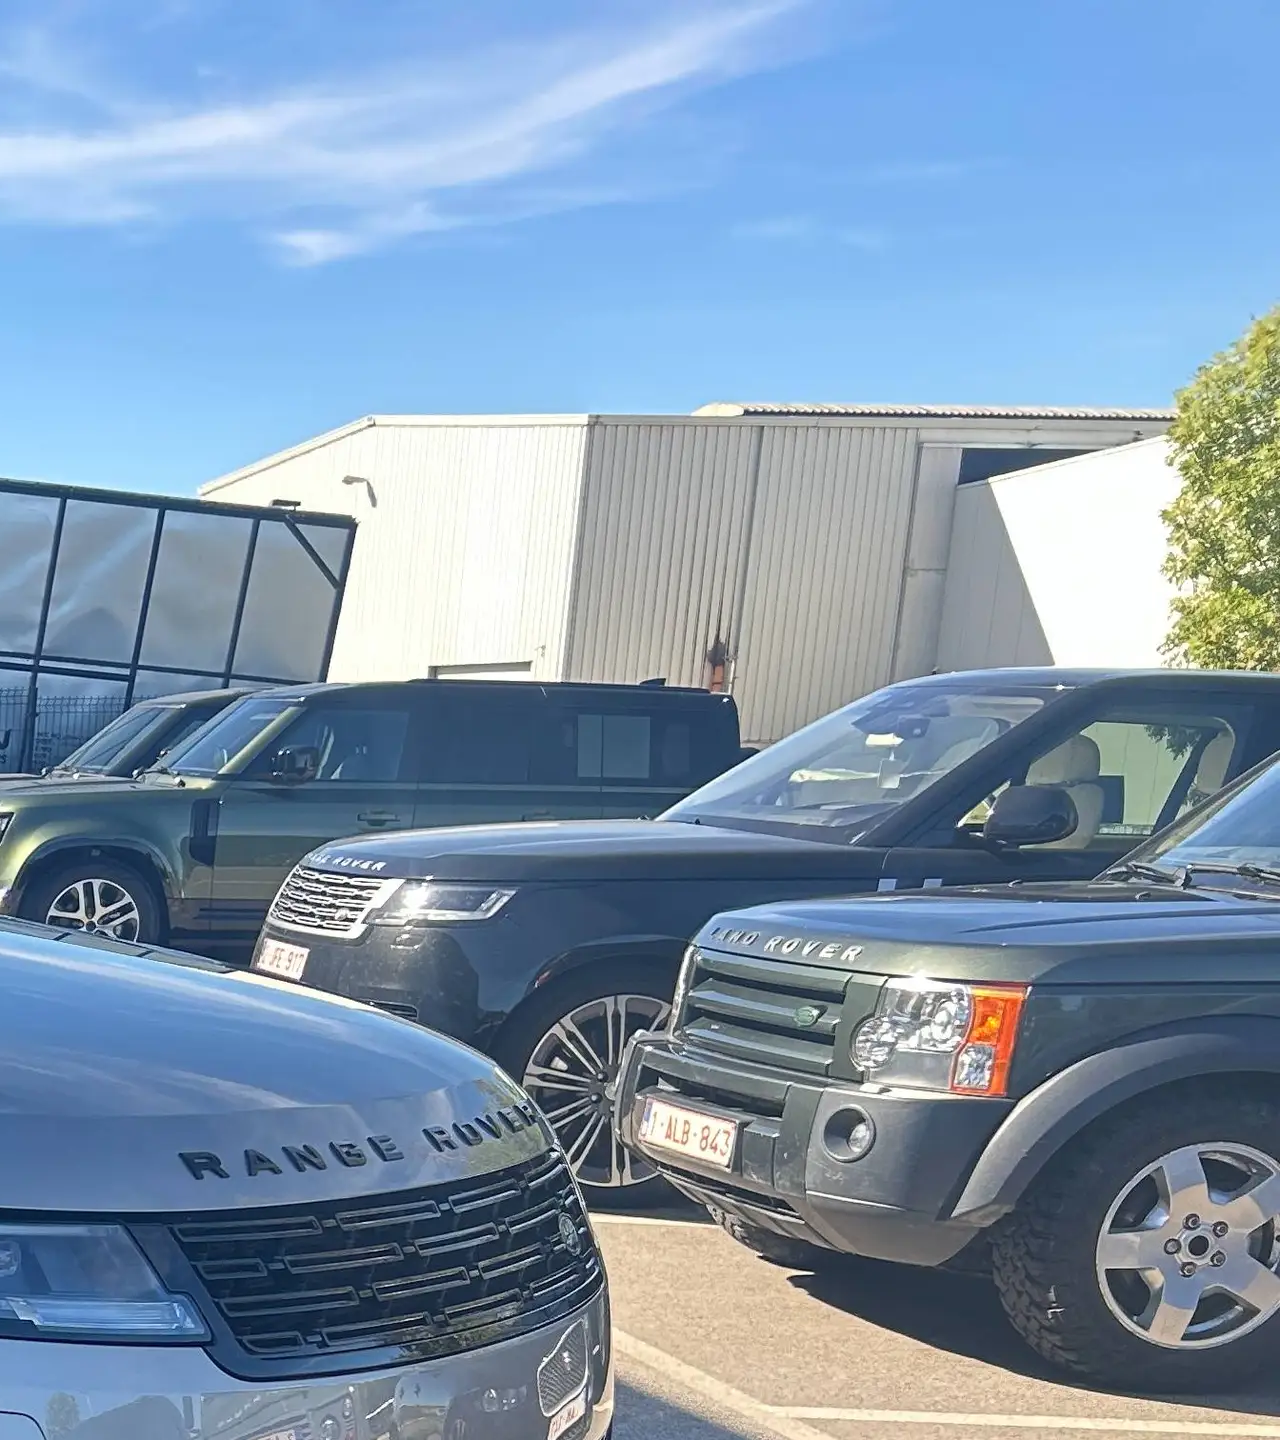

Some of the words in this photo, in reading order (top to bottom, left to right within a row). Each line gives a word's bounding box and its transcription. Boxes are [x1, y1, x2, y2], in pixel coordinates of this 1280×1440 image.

[710, 926, 761, 946] LAND
[763, 935, 865, 963] ROVER
[178, 1134, 405, 1181] RANGE
[421, 1102, 539, 1153] ROVER
